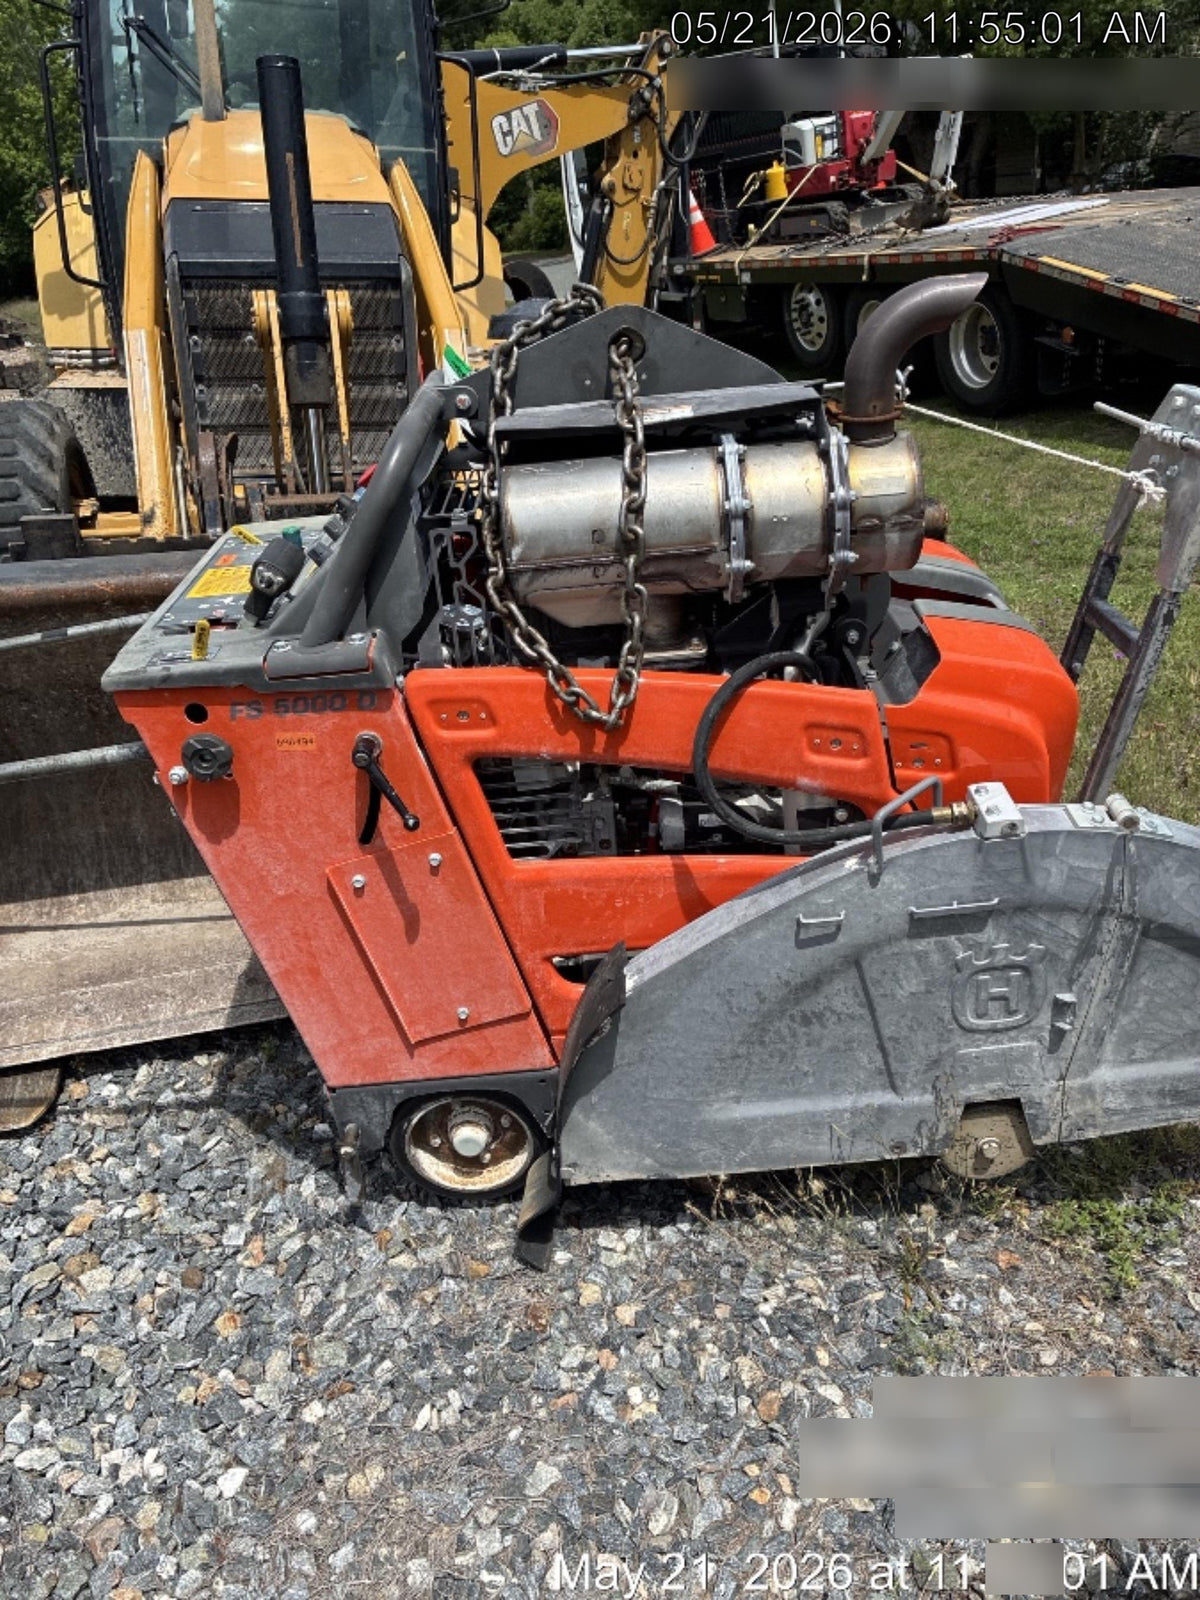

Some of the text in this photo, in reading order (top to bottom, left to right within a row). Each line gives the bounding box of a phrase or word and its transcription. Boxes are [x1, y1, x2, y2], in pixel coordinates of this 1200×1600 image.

[490, 101, 543, 156] CAT
[229, 689, 378, 721] FS 5000 D
